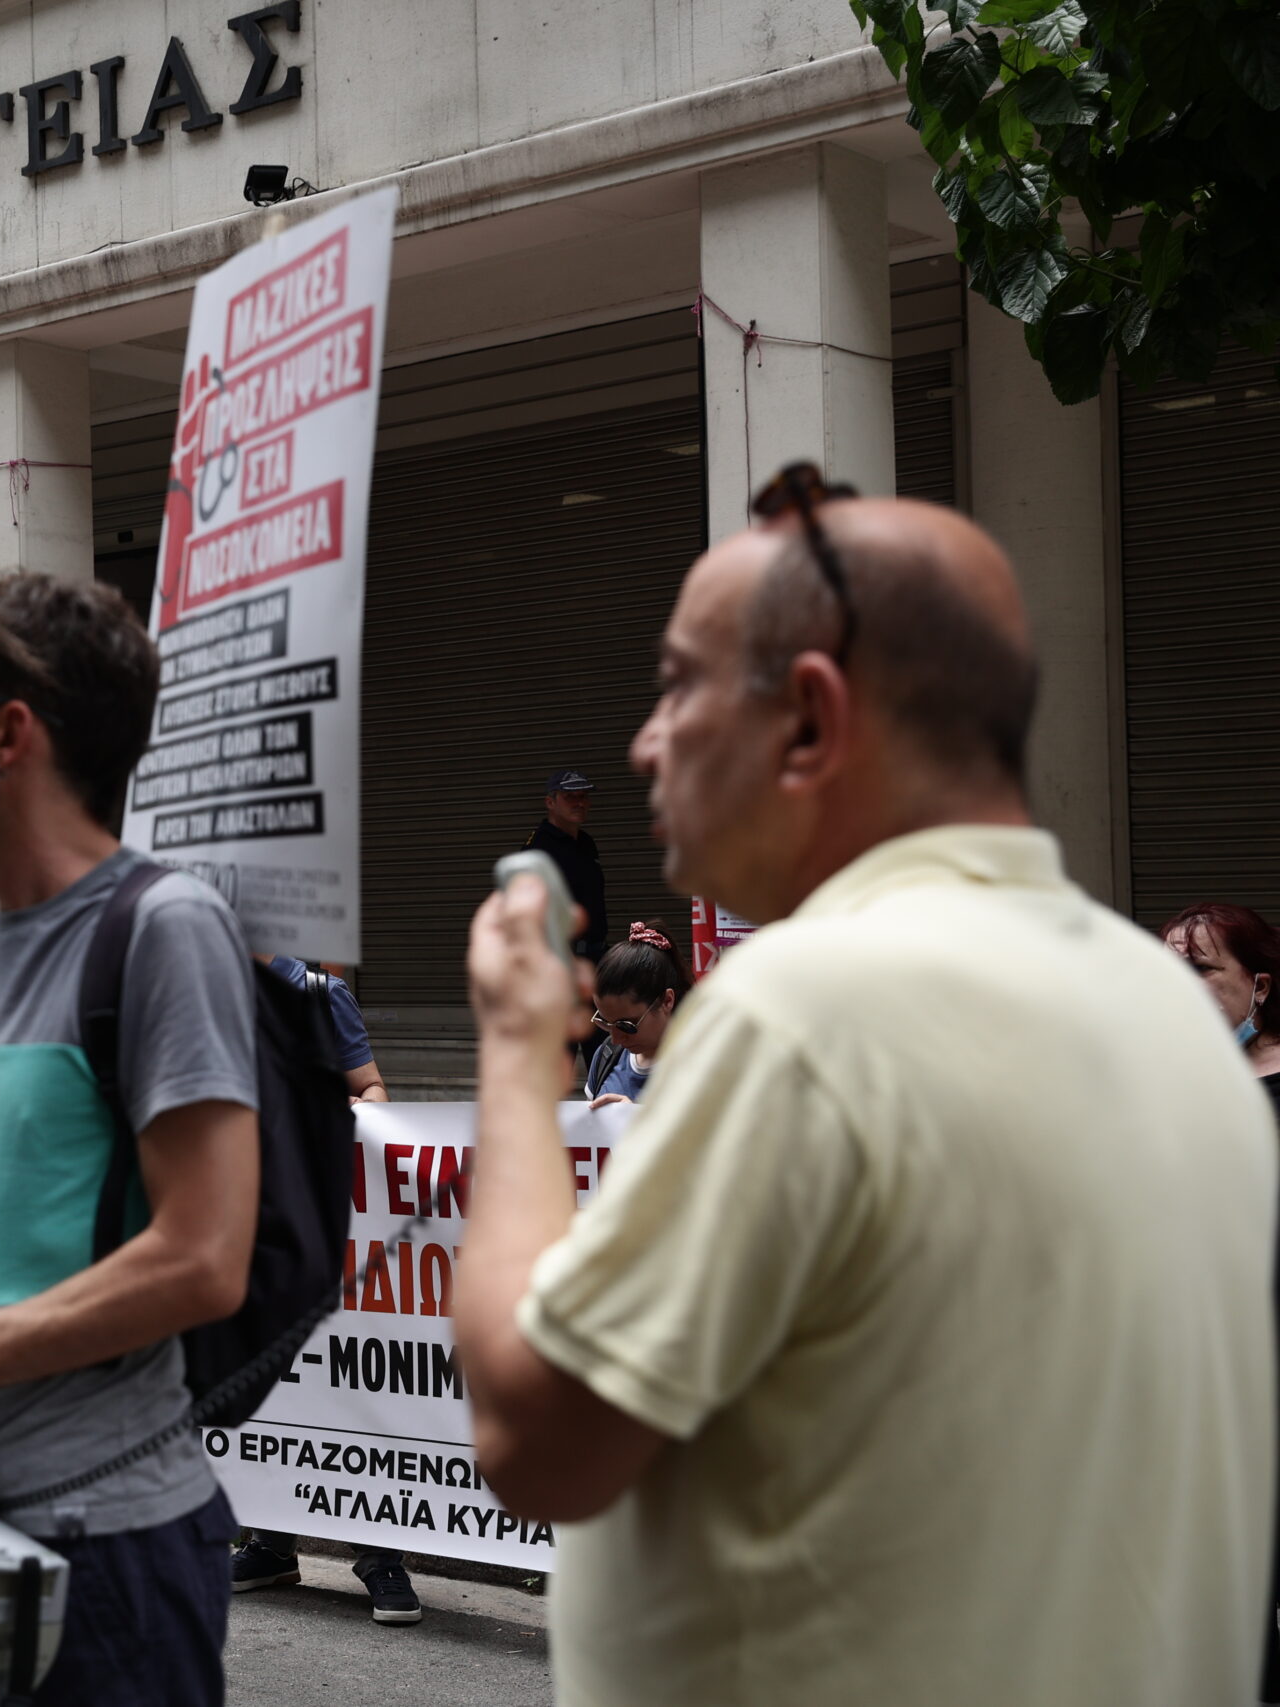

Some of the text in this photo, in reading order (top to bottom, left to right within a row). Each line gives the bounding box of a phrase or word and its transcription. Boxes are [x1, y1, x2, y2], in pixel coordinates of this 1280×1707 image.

[230, 244, 342, 359] ΜΑΖΙΚΕΣ
[203, 322, 365, 455] ΠΡΟΣΛΗΨΕΙΣ
[246, 438, 287, 500] ΣΤΑ
[188, 496, 332, 598] ΝΟΣΟΚΟΜΕΙΑ
[384, 1143, 476, 1219] ΕΙΝ
[341, 1239, 462, 1318] ΙΔΙΩ
[447, 1503, 557, 1548] ΚΥΡΙΑ
